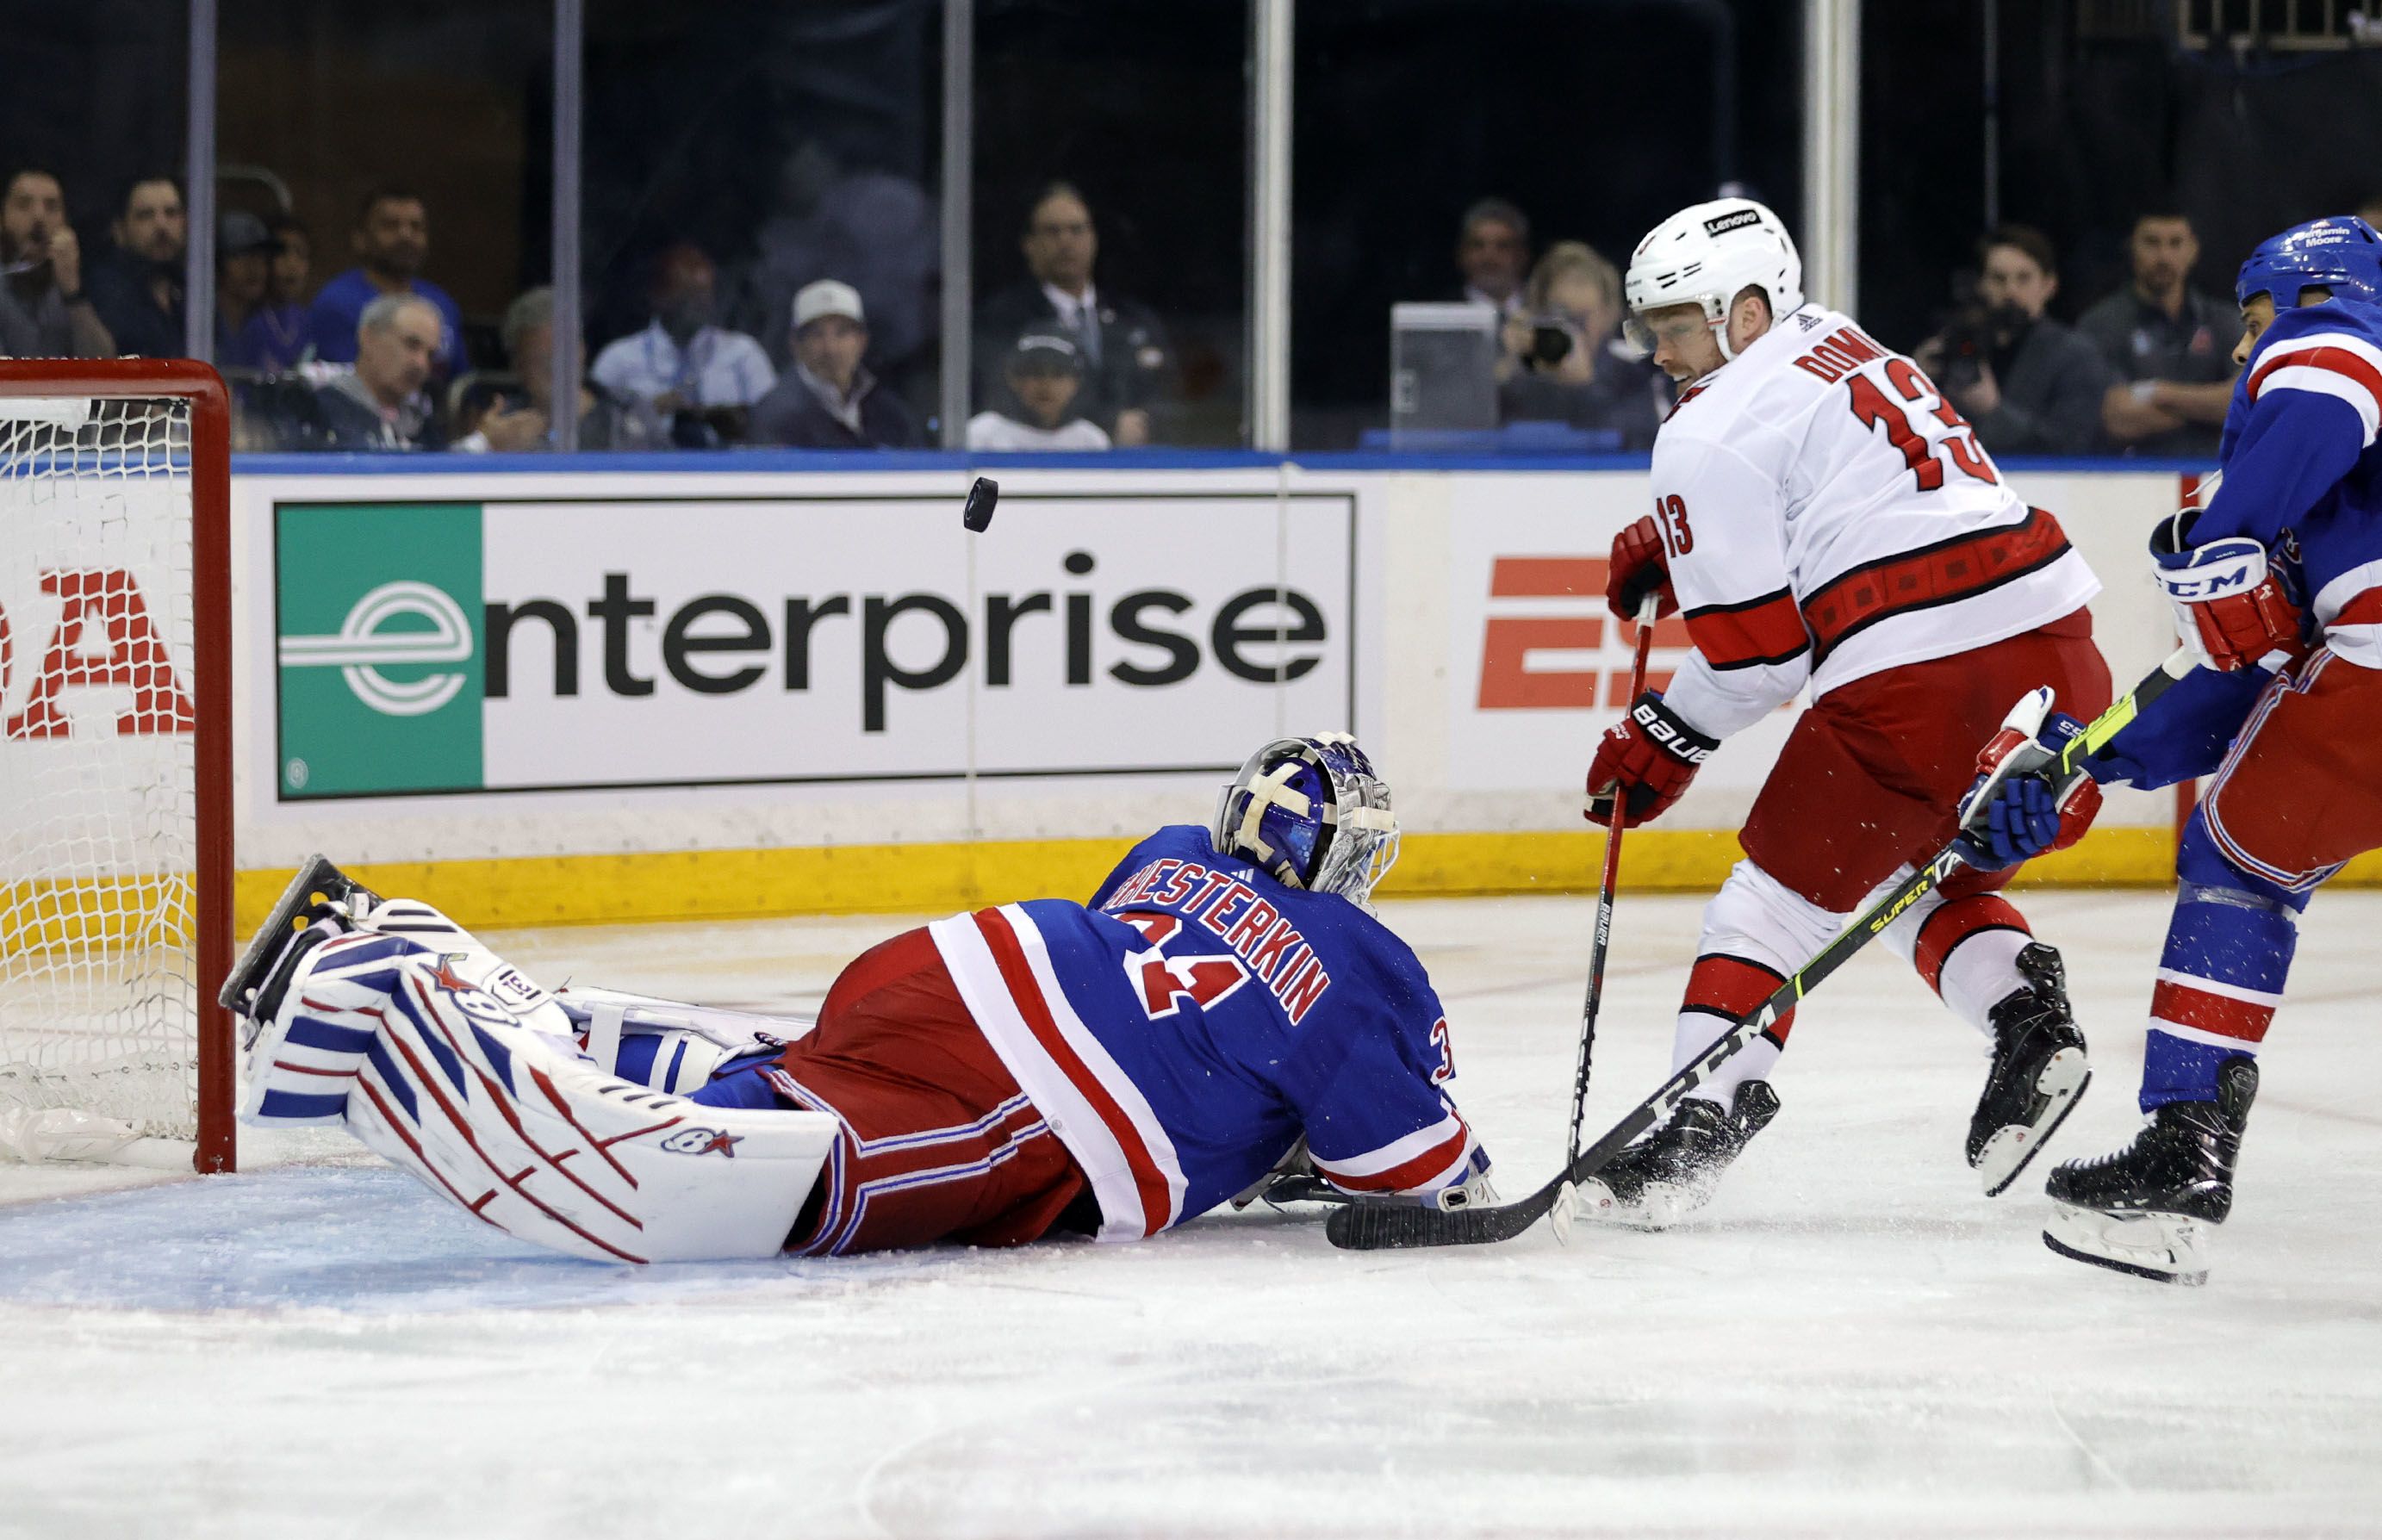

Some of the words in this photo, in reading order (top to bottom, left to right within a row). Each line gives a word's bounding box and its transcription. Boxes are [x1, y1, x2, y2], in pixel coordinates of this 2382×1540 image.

[1707, 211, 1757, 233] Lenovo
[2305, 237, 2343, 248] Moore
[1845, 357, 1999, 492] 13
[1656, 494, 1694, 558] 13
[280, 550, 1328, 733] enterprise
[1869, 880, 1929, 933] SUPER
